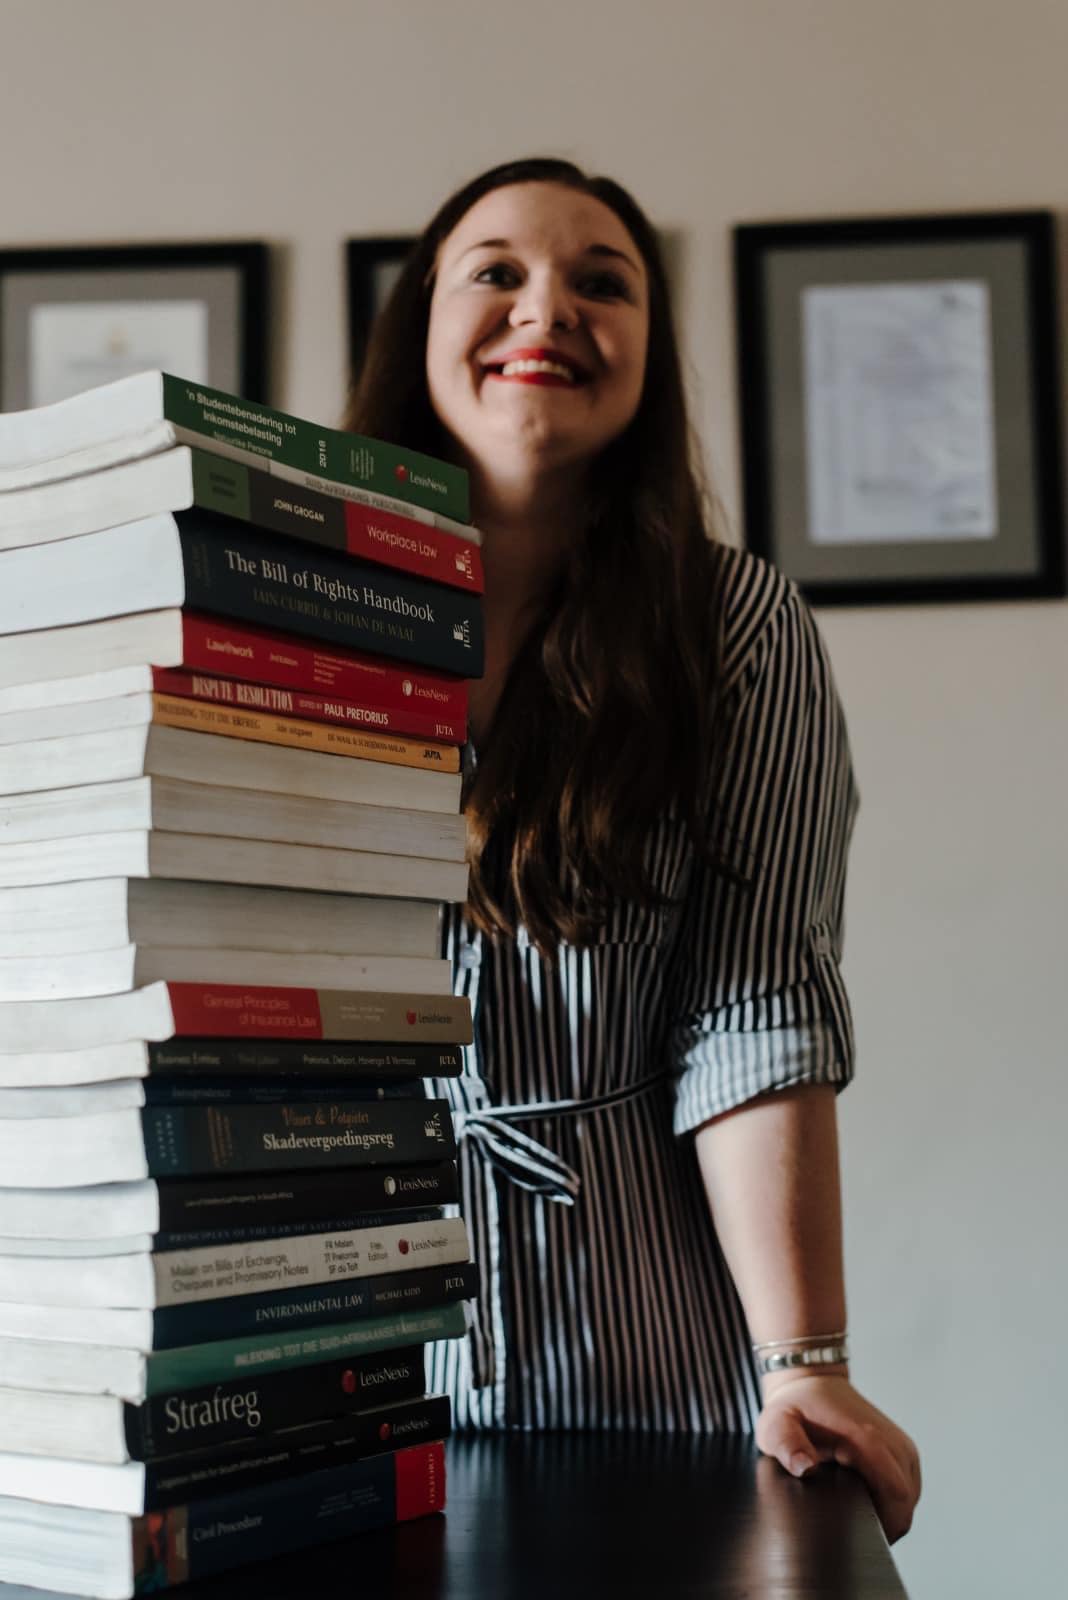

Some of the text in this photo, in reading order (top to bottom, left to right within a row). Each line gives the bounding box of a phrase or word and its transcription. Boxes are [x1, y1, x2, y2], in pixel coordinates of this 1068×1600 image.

[284, 423, 297, 435] tot
[273, 498, 325, 523] JOHN GROGAN
[367, 525, 438, 559] Workplace Law
[224, 549, 257, 575] The
[262, 559, 288, 584] Bill
[292, 571, 308, 589] of
[312, 573, 359, 602] Rights
[363, 587, 435, 623] Handbook
[192, 675, 293, 713] DISPUTE RESOLUTION
[323, 703, 345, 718] PAUL
[346, 706, 389, 725] PRETORIUS
[434, 723, 454, 737] JUTA
[422, 748, 442, 761] JUTA
[239, 1012, 248, 1025] of
[297, 1014, 317, 1027] Law
[439, 1055, 457, 1067] JUTA
[262, 1129, 395, 1152] Skadevergoedingsreg
[398, 1177, 440, 1192] LexisNexis
[234, 1257, 244, 1269] of
[337, 1263, 347, 1273] du
[215, 1275, 233, 1286] and
[283, 1264, 309, 1277] Notes
[445, 1277, 465, 1291] JUTA
[255, 1293, 365, 1321] ENVIRONMENTAL LAW
[360, 1366, 410, 1387] LexisNexis
[165, 1385, 262, 1434] Strafreg
